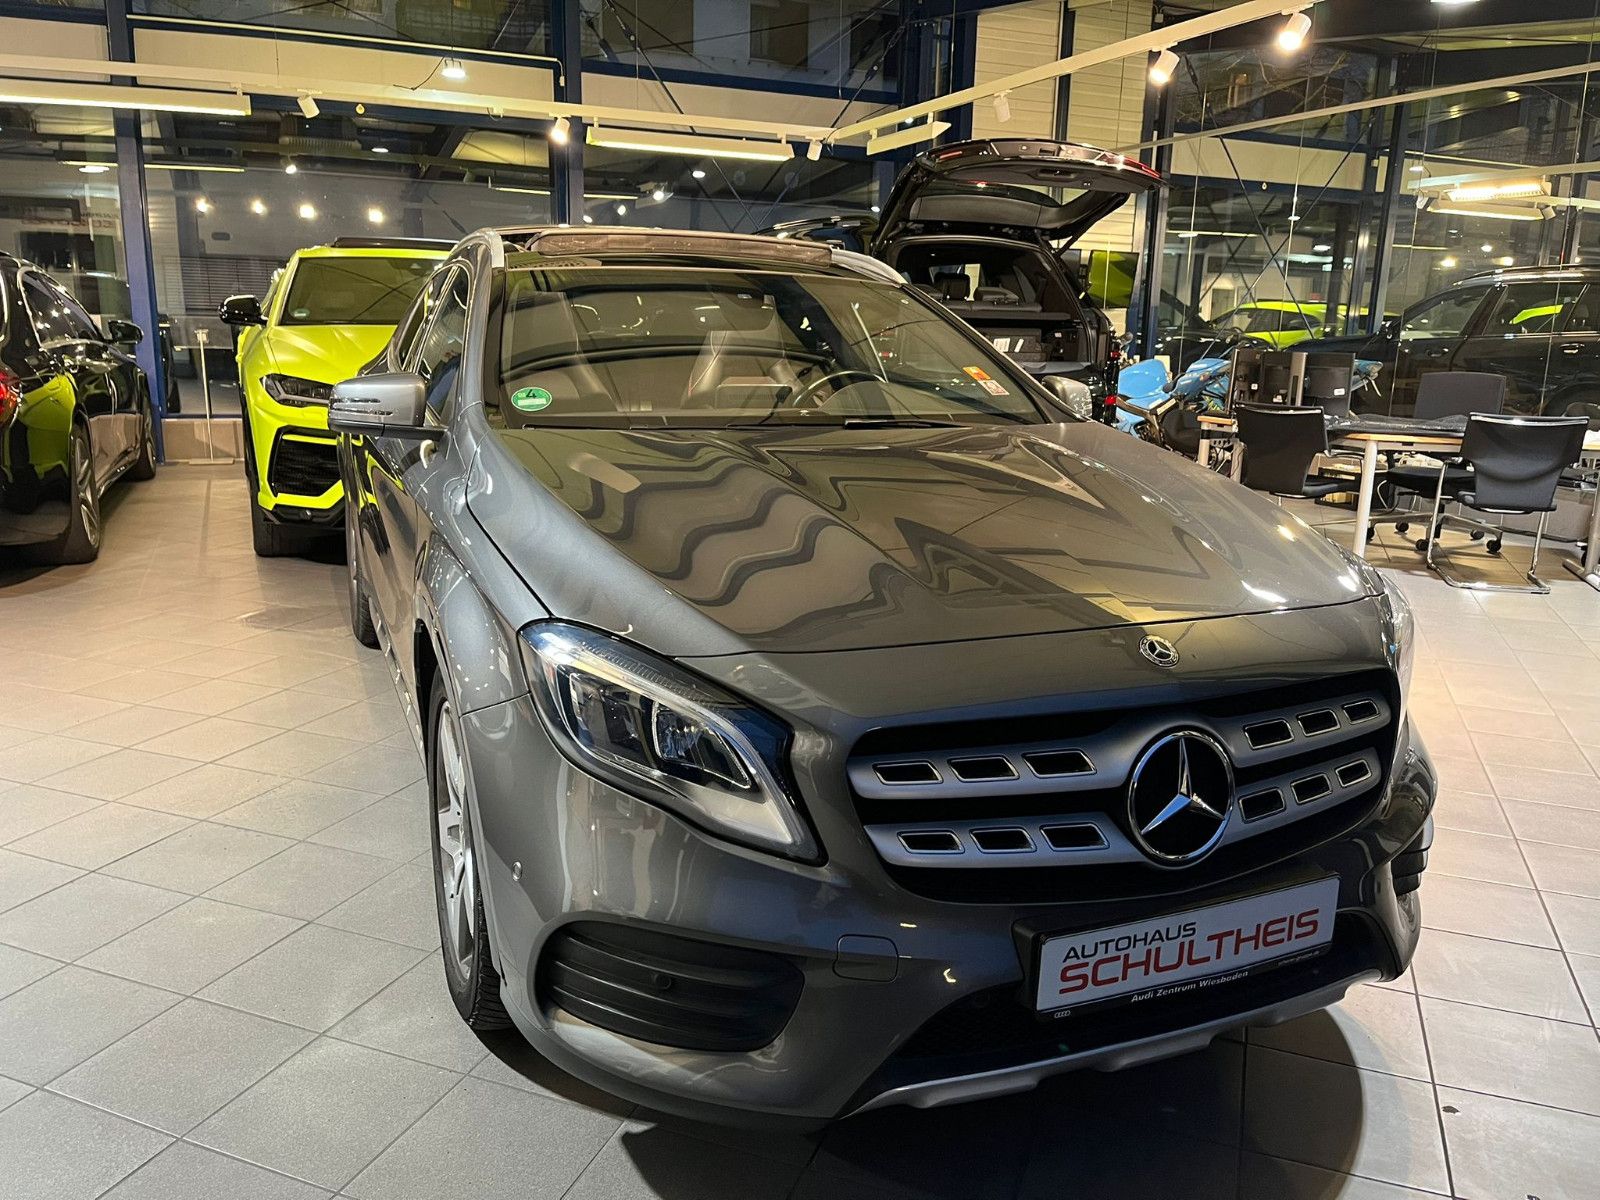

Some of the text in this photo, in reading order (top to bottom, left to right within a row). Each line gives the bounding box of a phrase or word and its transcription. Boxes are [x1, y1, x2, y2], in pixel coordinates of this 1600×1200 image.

[526, 389, 537, 399] 4
[1059, 909, 1319, 994] SCHULTHEIS
[1063, 921, 1196, 962] AUTOHAUS
[1131, 971, 1248, 1002] Audi Zentrum Wiesbaden
